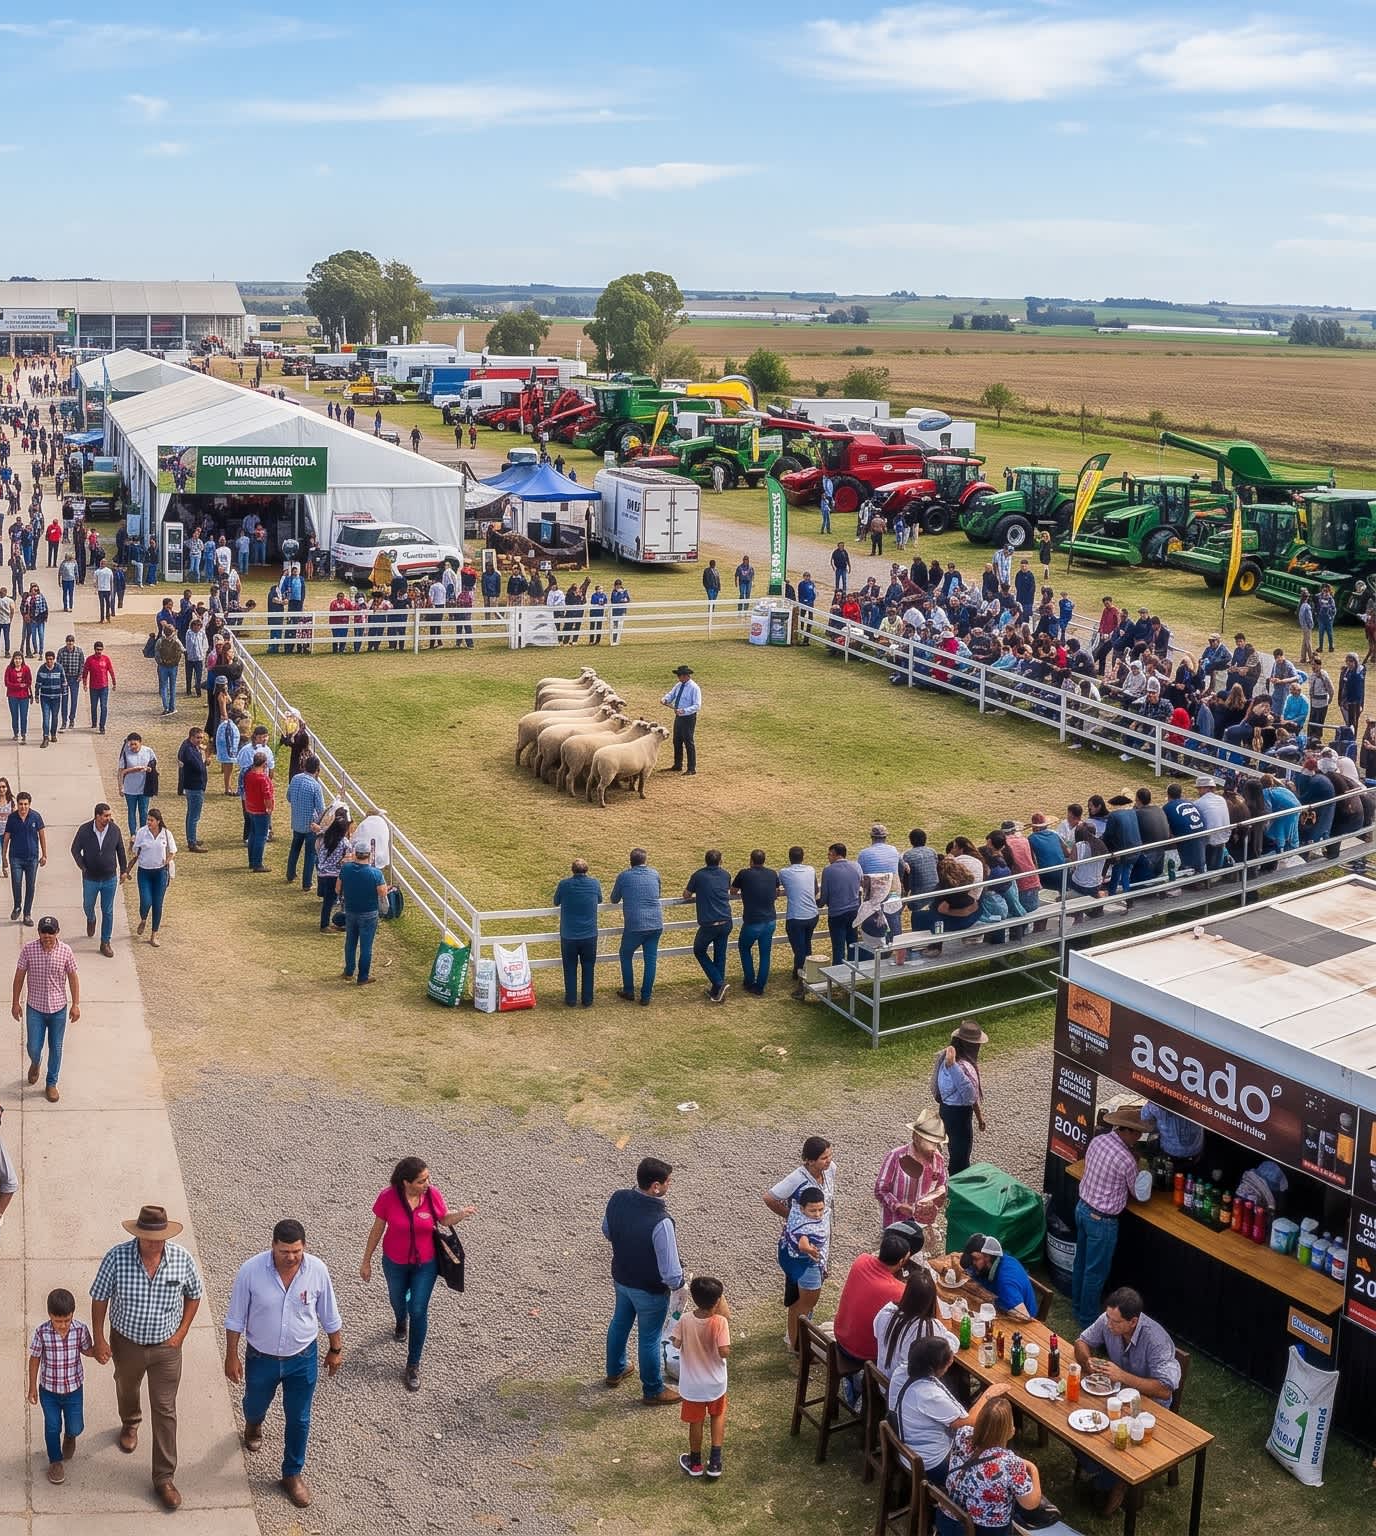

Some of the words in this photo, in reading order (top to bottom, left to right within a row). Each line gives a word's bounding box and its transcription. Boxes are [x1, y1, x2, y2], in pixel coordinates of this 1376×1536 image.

[271, 454, 317, 467] AGRÍCOLA
[226, 467, 233, 477] Y
[1131, 1034, 1271, 1123] asado
